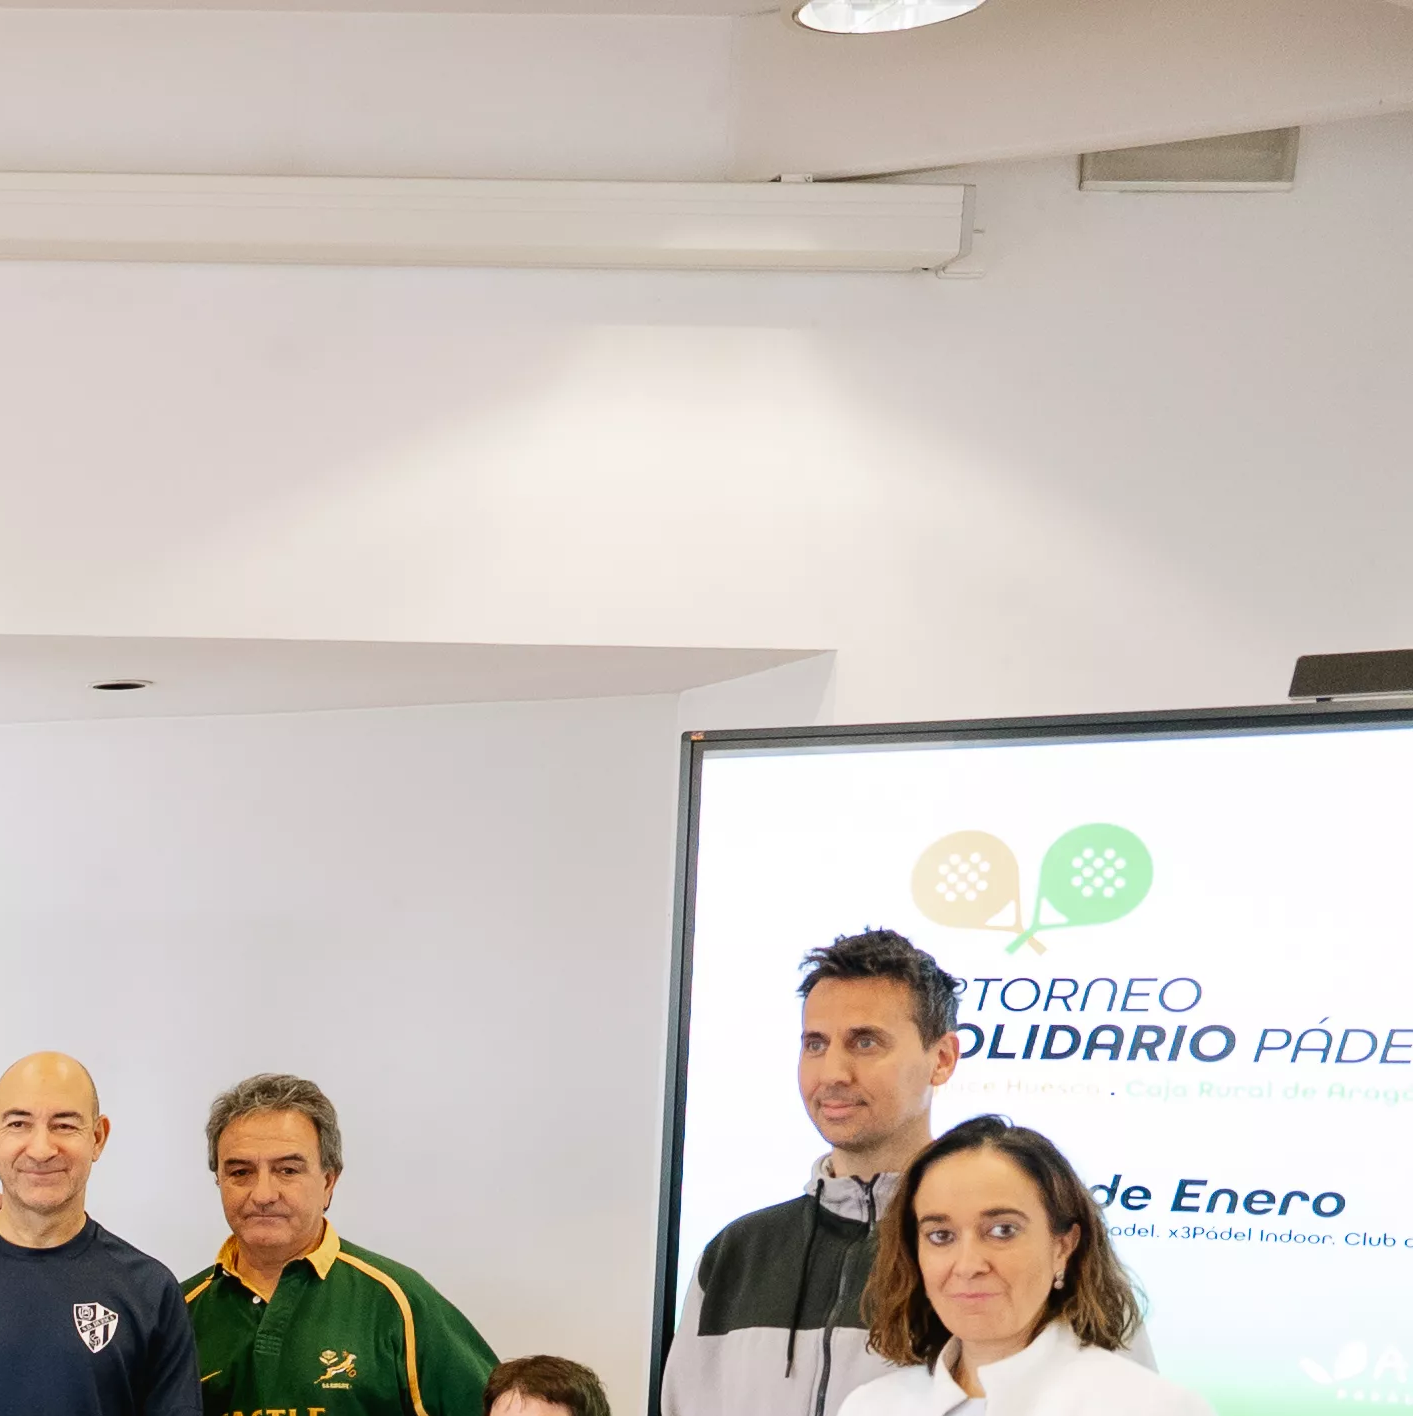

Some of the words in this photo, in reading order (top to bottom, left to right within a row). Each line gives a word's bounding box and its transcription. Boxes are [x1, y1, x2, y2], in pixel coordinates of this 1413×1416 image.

[1253, 1017, 1413, 1064] PÁDE
[1124, 1076, 1191, 1102] Caja
[1199, 1077, 1272, 1099] Rural
[1283, 1080, 1318, 1101] de
[1170, 1178, 1346, 1218] Enero
[1344, 1231, 1397, 1249] Club
